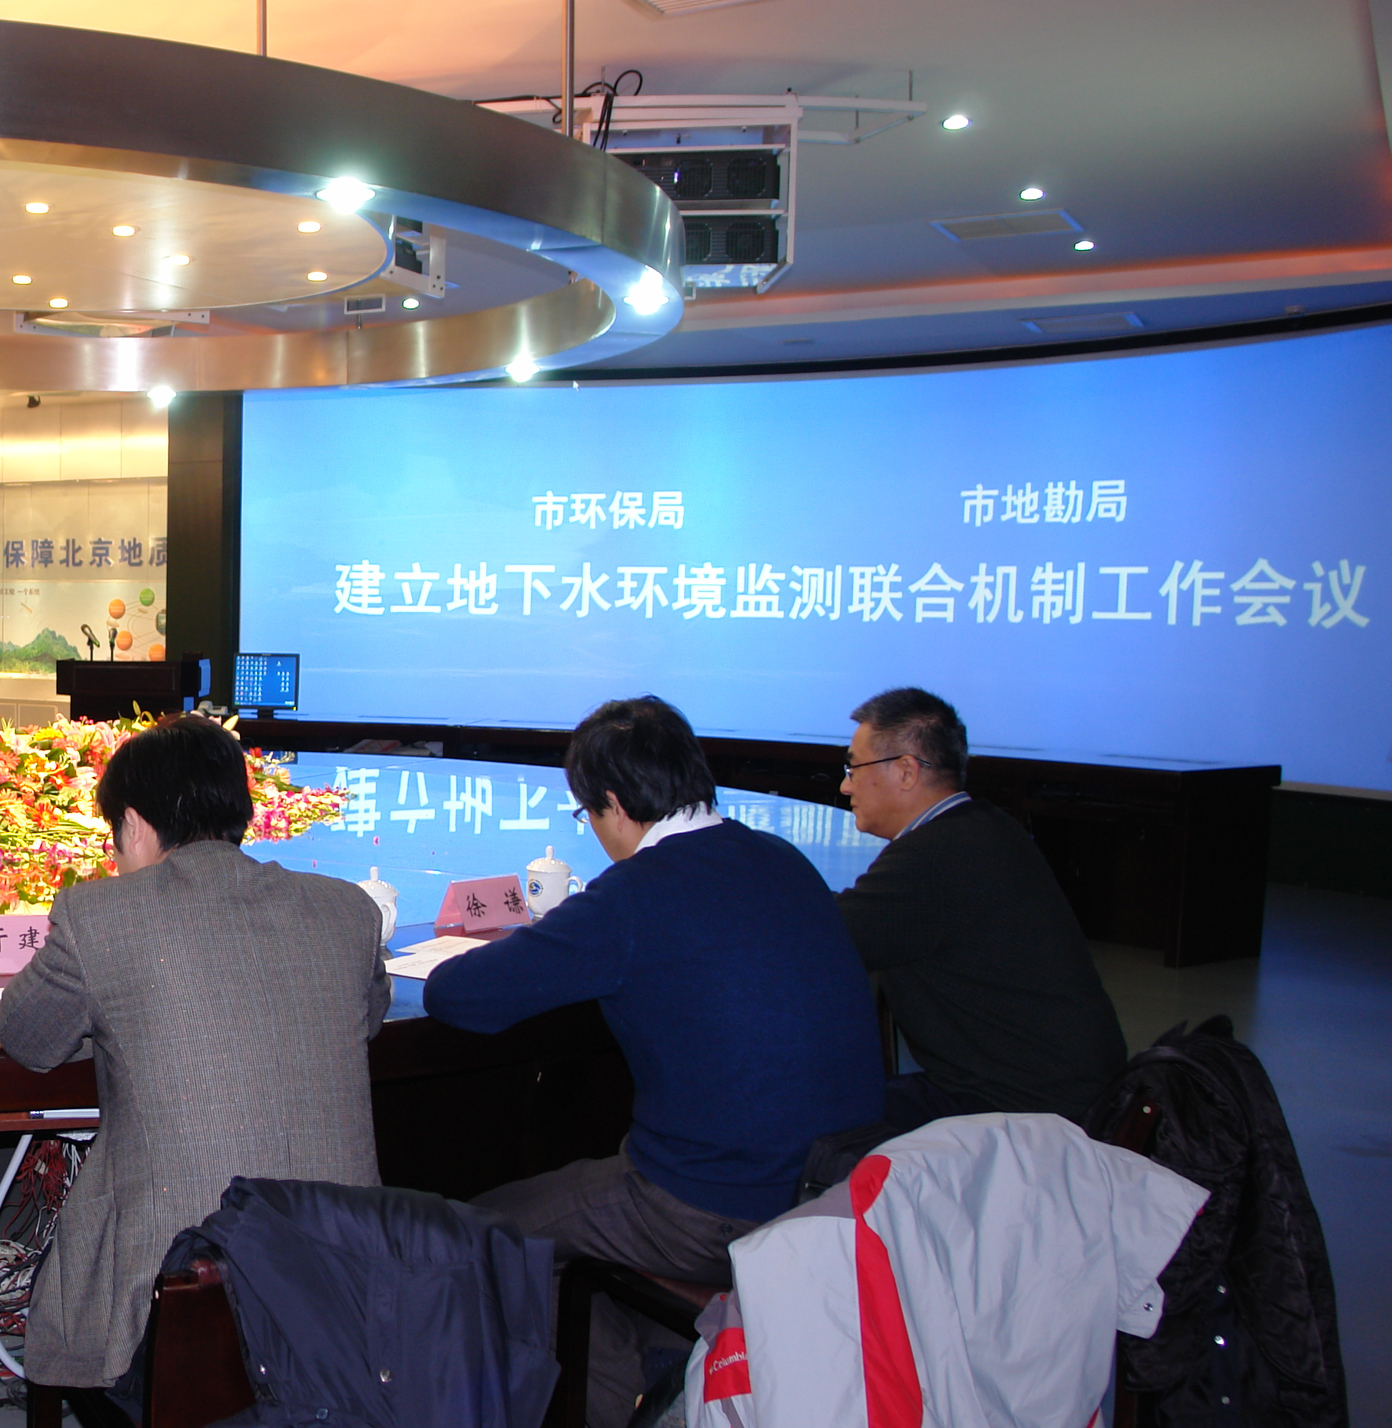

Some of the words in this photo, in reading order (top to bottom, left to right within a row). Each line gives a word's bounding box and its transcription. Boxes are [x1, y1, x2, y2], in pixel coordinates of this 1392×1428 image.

[532, 490, 685, 531] 市环保局
[961, 480, 1127, 527] 市地勘局
[3, 538, 167, 569] 保障北京地质
[334, 558, 1371, 629] 建立地下水环境监测联合机制工作会议
